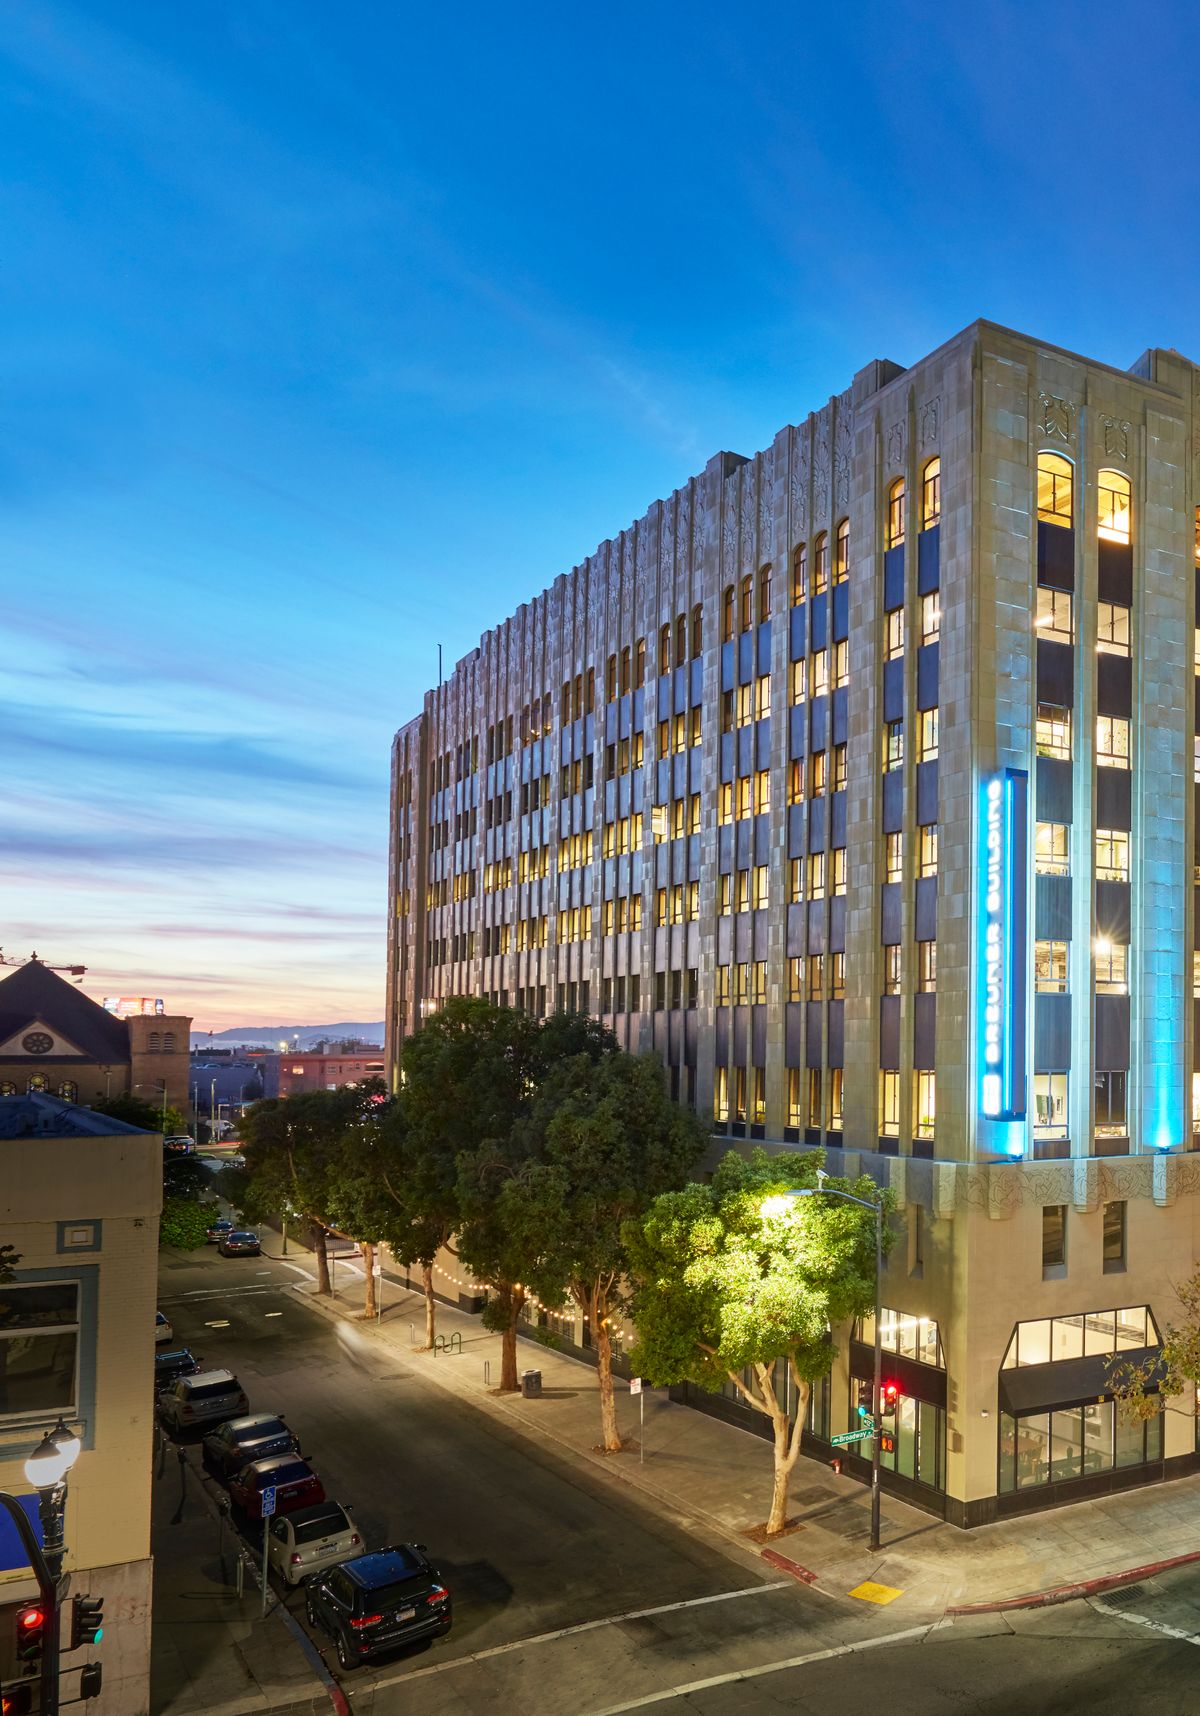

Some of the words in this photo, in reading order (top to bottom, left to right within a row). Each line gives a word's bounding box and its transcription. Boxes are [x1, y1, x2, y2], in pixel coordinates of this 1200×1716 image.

[987, 779, 1000, 912] BUILDING
[986, 922, 999, 1063] BREUNER
[839, 1431, 866, 1442] Broadway
